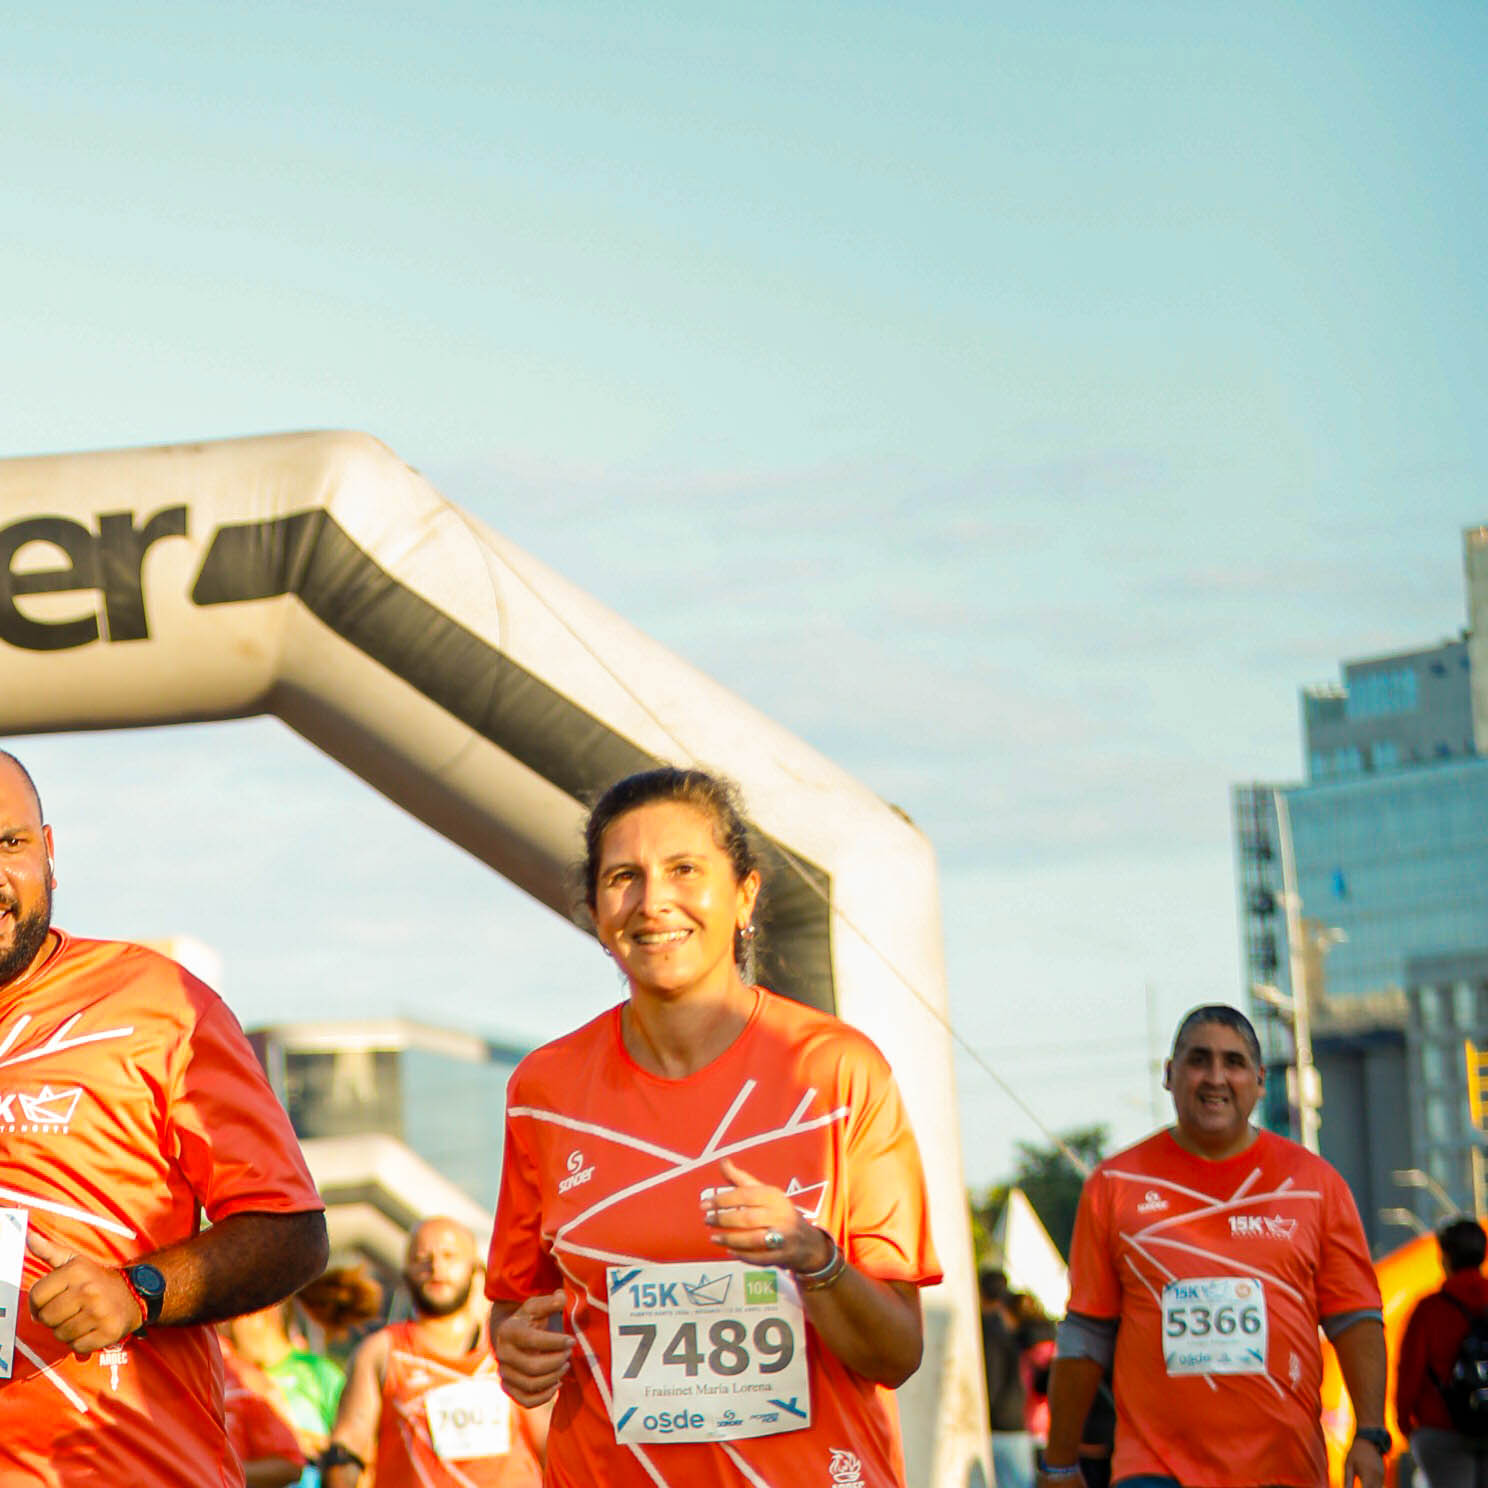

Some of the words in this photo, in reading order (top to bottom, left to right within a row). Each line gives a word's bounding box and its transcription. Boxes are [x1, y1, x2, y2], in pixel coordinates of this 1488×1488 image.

[1228, 1216, 1262, 1233] 15K
[629, 1282, 679, 1308] 15K
[747, 1281, 774, 1296] 10K
[1166, 1305, 1261, 1337] 5366
[619, 1318, 794, 1379] 7489
[643, 1409, 704, 1432] osde
